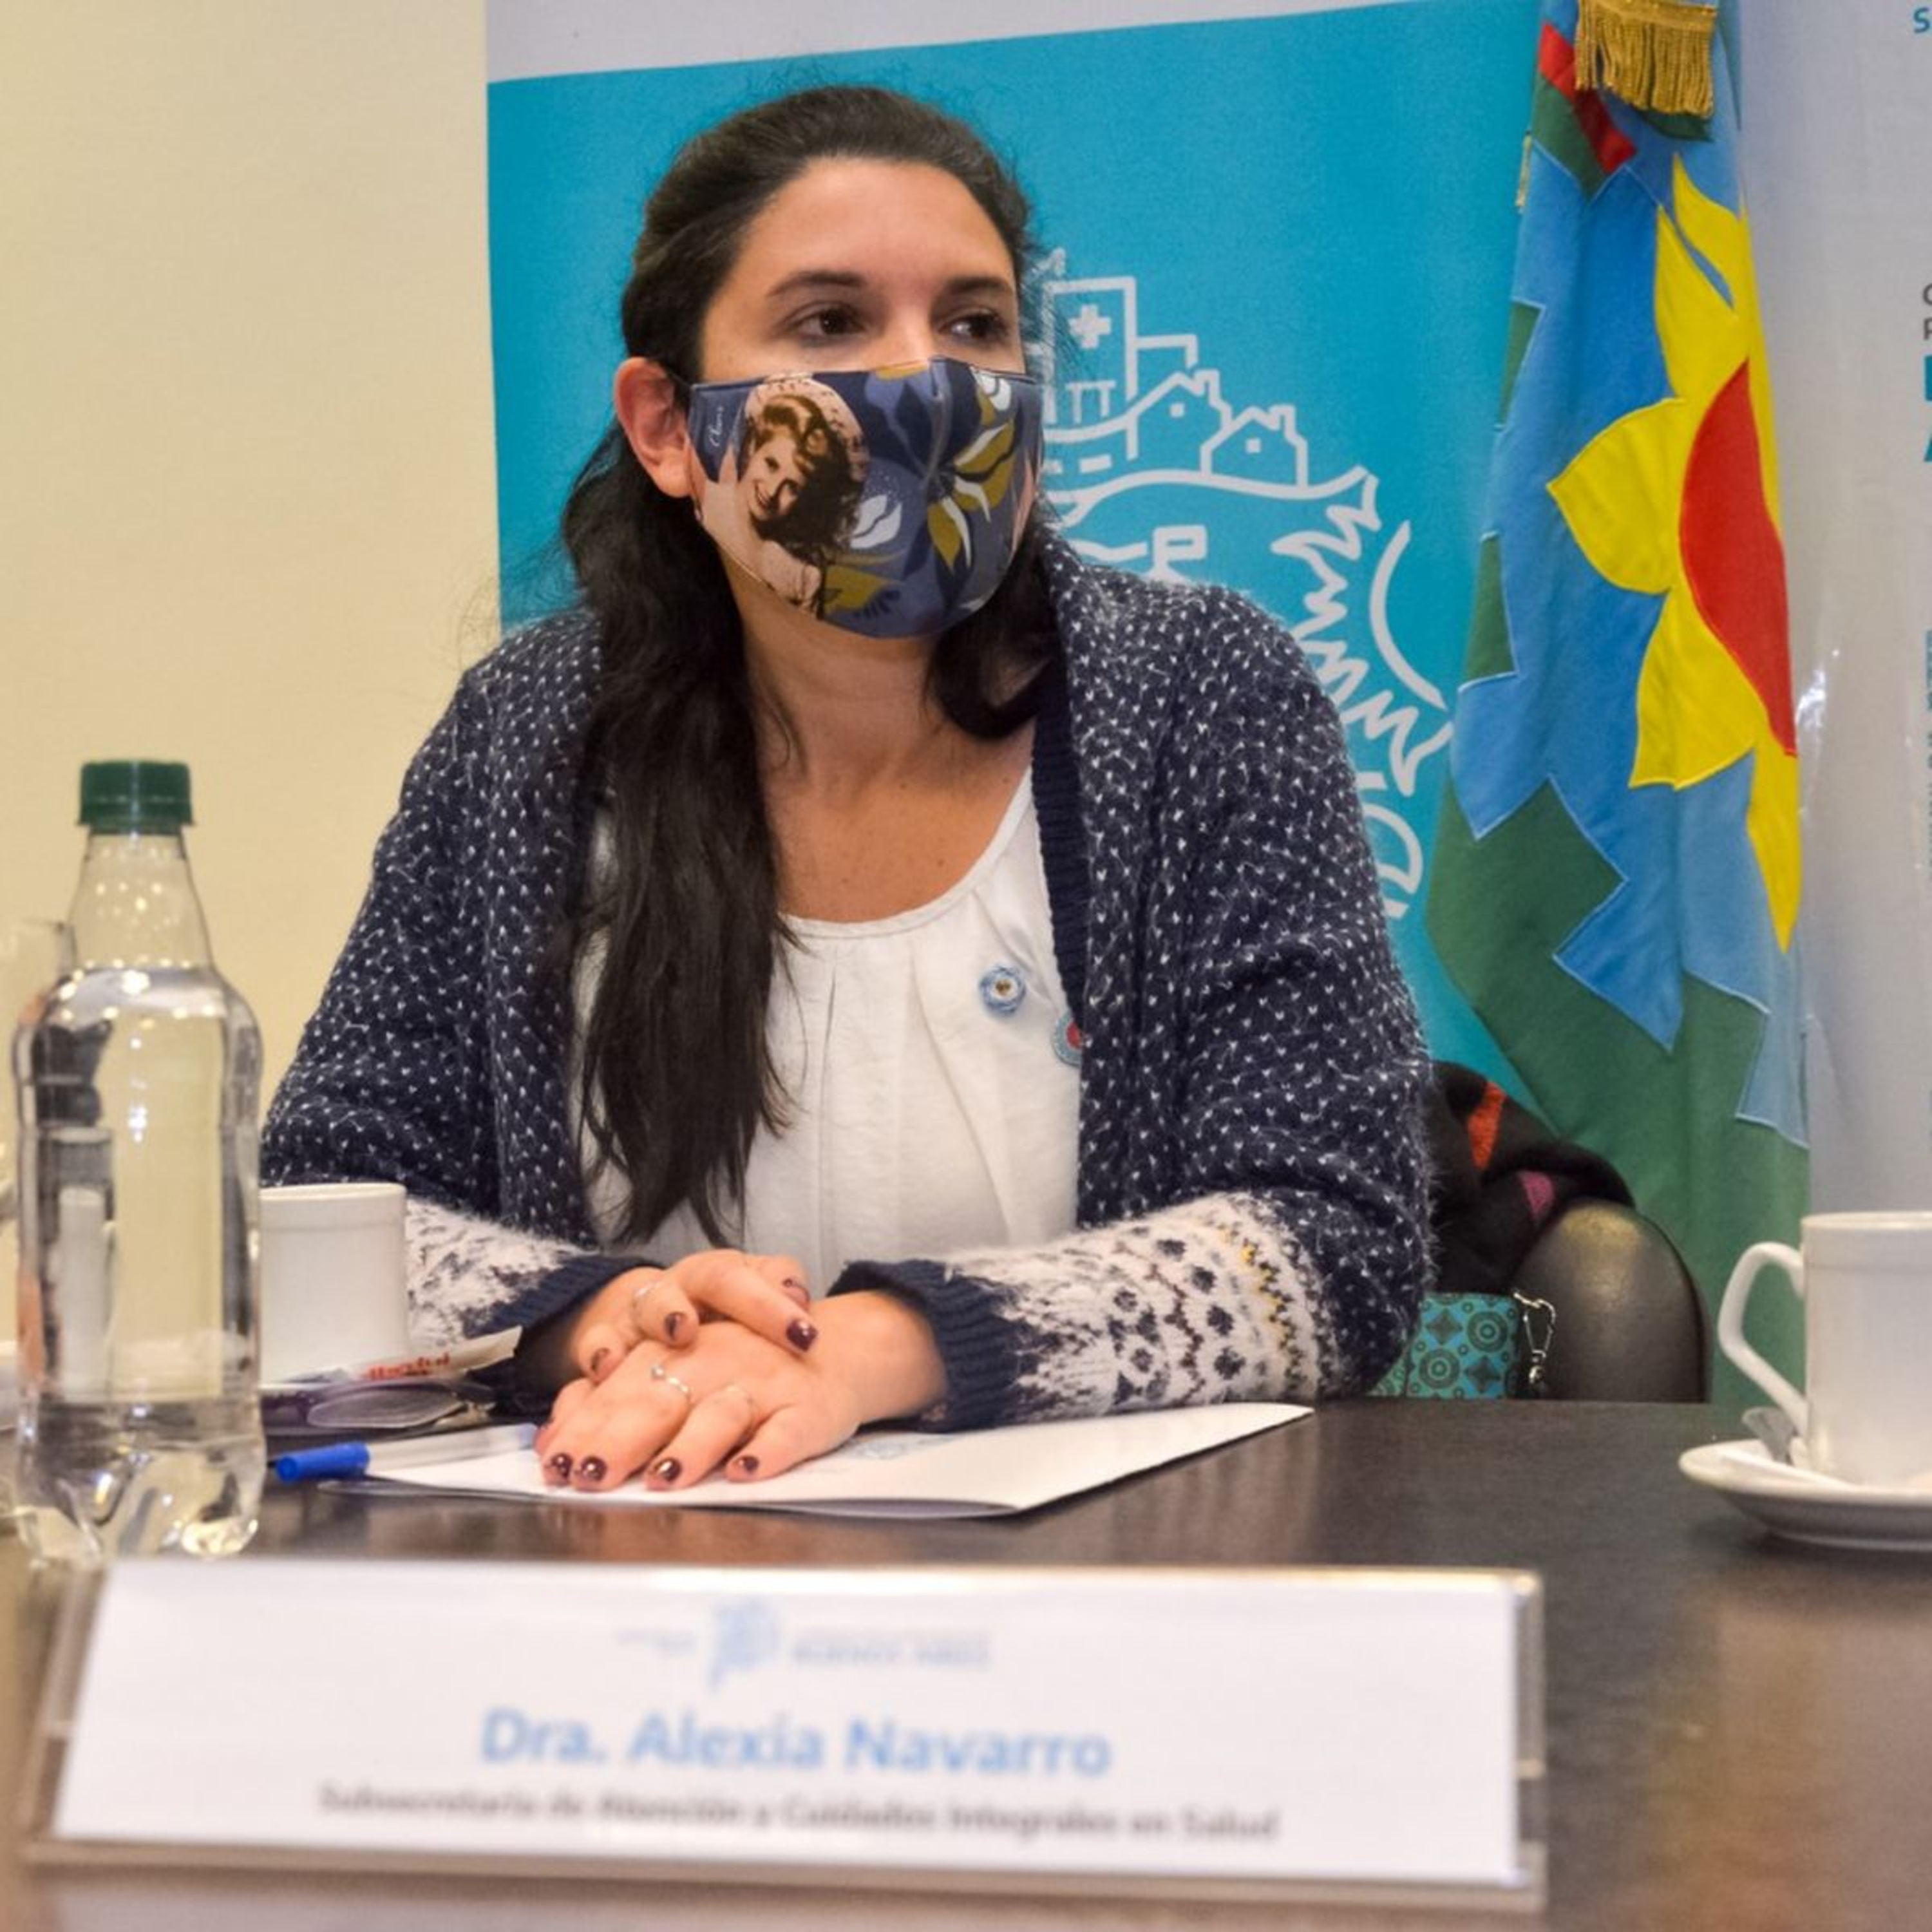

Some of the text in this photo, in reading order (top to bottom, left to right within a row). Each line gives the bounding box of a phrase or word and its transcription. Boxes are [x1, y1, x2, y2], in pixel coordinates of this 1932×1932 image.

[480, 1708, 1112, 1777] Dra. Alexia Navarro
[549, 1786, 582, 1818] de
[753, 1801, 772, 1829] y
[1131, 1810, 1169, 1833] en
[1184, 1803, 1280, 1841] Salud
